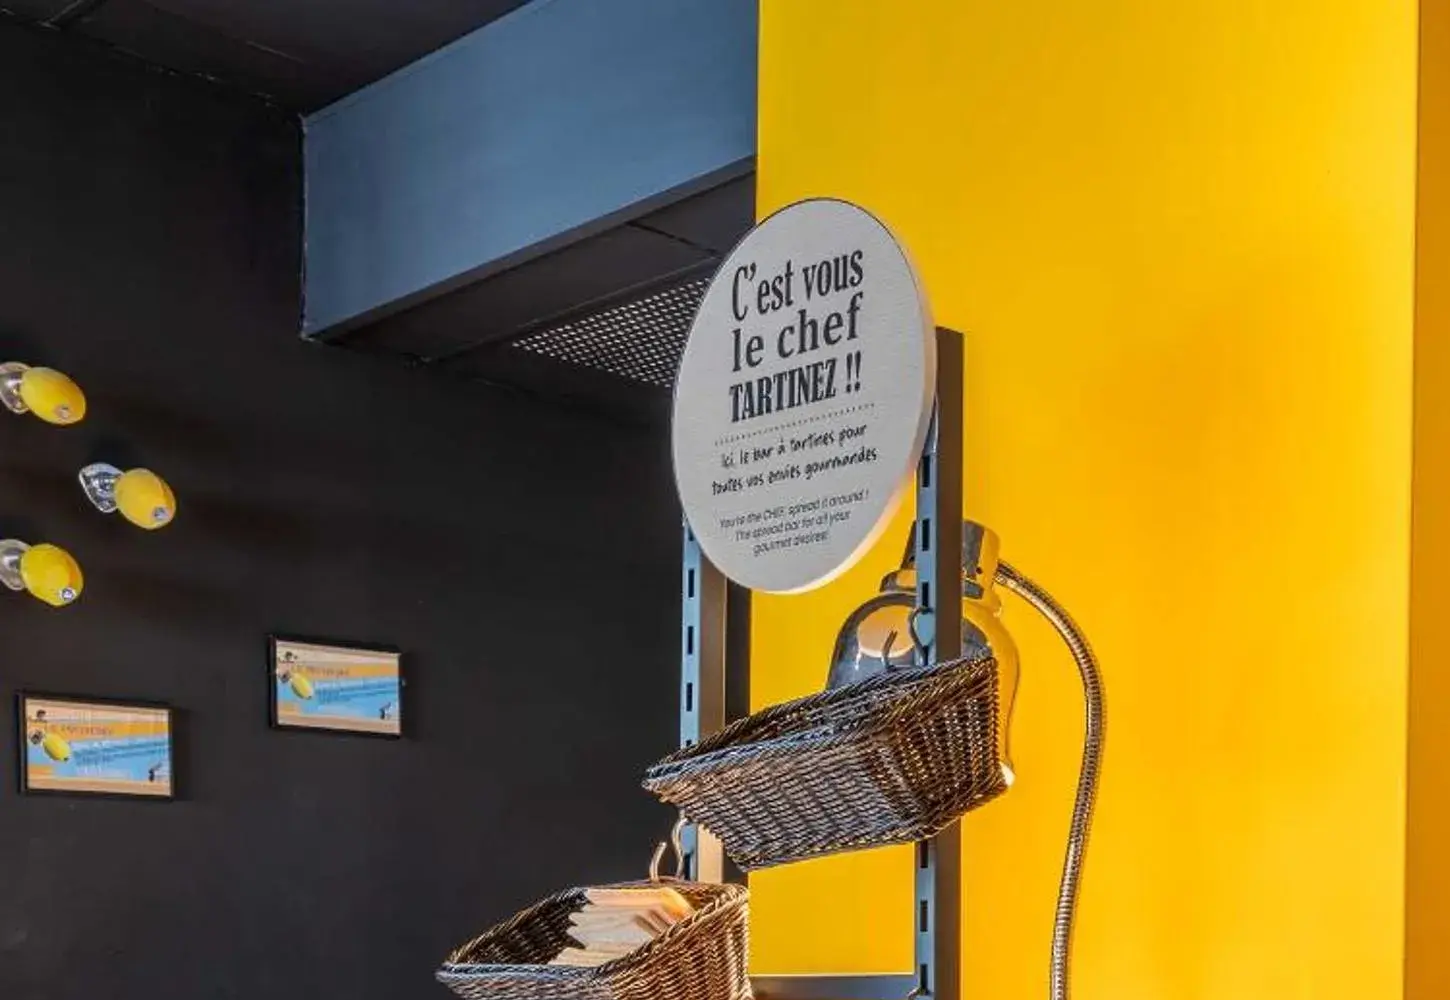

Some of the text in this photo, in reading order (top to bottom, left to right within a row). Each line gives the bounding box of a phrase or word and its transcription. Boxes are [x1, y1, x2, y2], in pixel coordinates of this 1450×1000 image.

[732, 249, 863, 321] C'est vous
[732, 291, 864, 372] le chef
[729, 350, 862, 422] TARTINEZ !!
[712, 445, 877, 496] toutes vos envies gourmandes
[740, 449, 749, 464] le
[790, 429, 834, 453] tartines
[838, 424, 867, 447] pour
